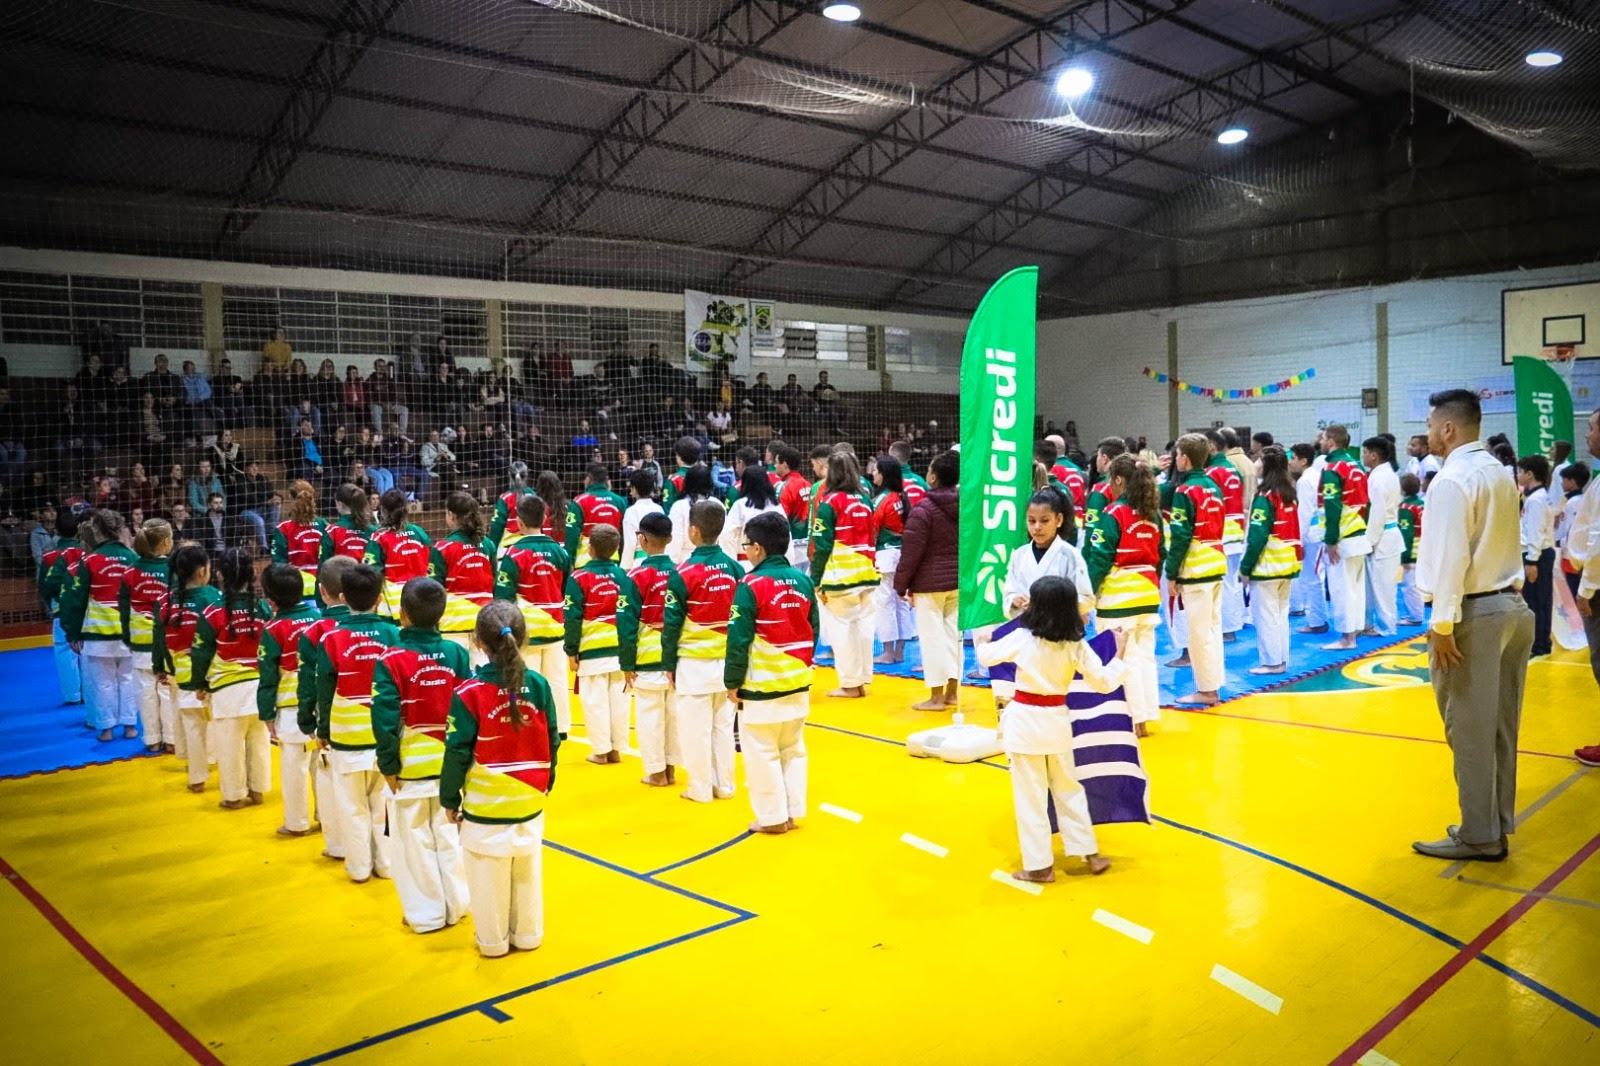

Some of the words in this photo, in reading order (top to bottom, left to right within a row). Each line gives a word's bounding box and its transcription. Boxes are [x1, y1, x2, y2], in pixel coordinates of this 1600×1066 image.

[1532, 391, 1555, 460] credi
[982, 347, 1017, 532] Sicredi
[704, 562, 729, 572] ATLETA
[773, 578, 798, 587] ATLETA
[708, 584, 731, 592] Karate
[350, 630, 380, 638] ATLETA
[417, 651, 446, 662] ATLETA
[419, 678, 447, 687] Karate
[497, 686, 530, 696] ATTA
